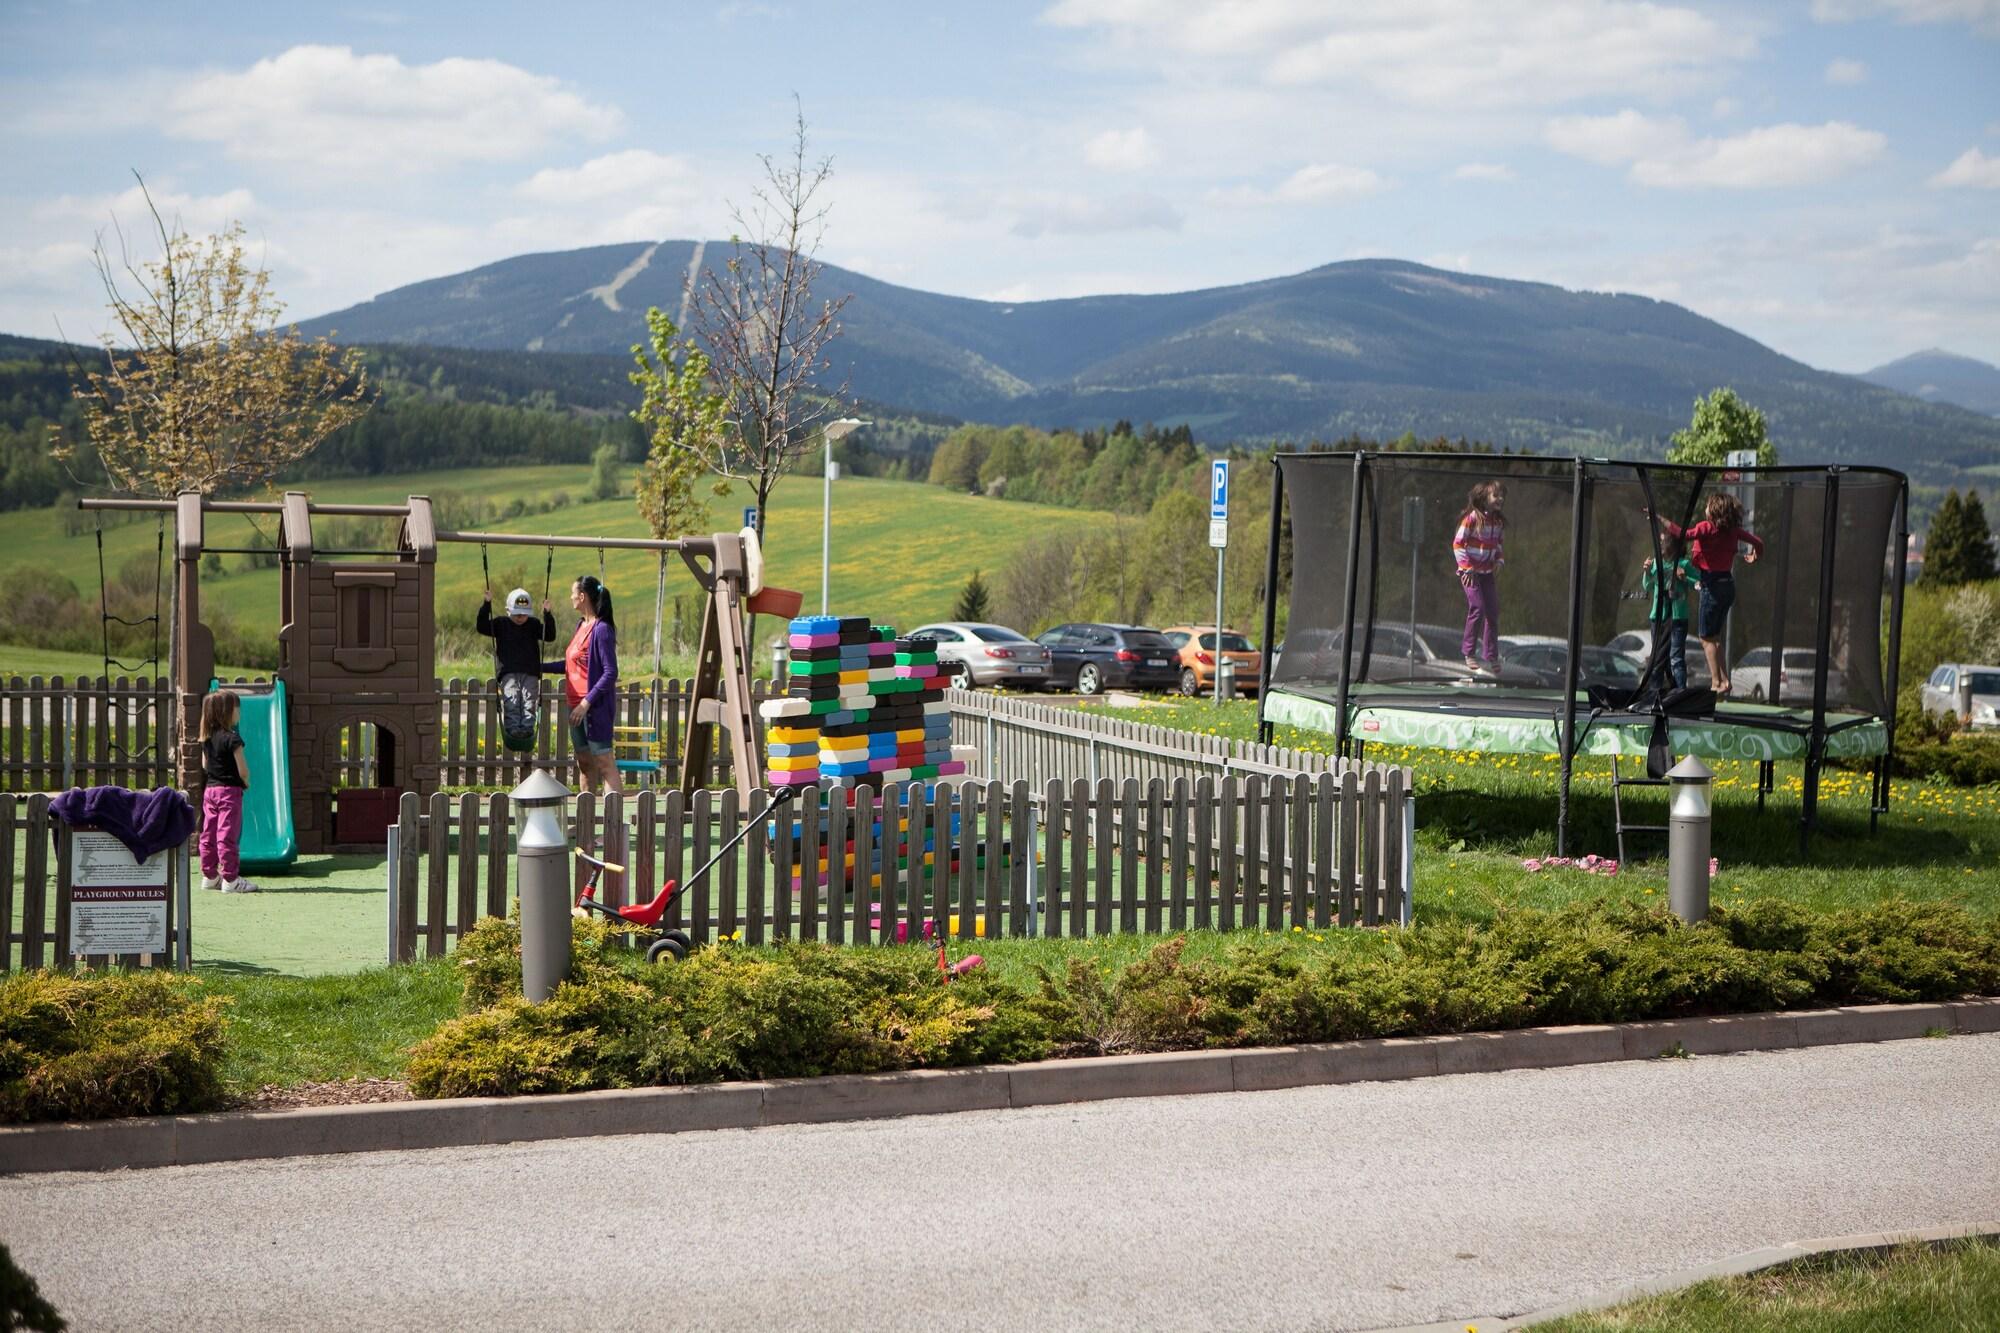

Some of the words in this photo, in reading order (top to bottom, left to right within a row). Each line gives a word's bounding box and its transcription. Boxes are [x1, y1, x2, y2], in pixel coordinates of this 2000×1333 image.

[1214, 467, 1225, 501] P
[74, 890, 134, 899] PLAYGROUND
[136, 889, 165, 898] RULES
